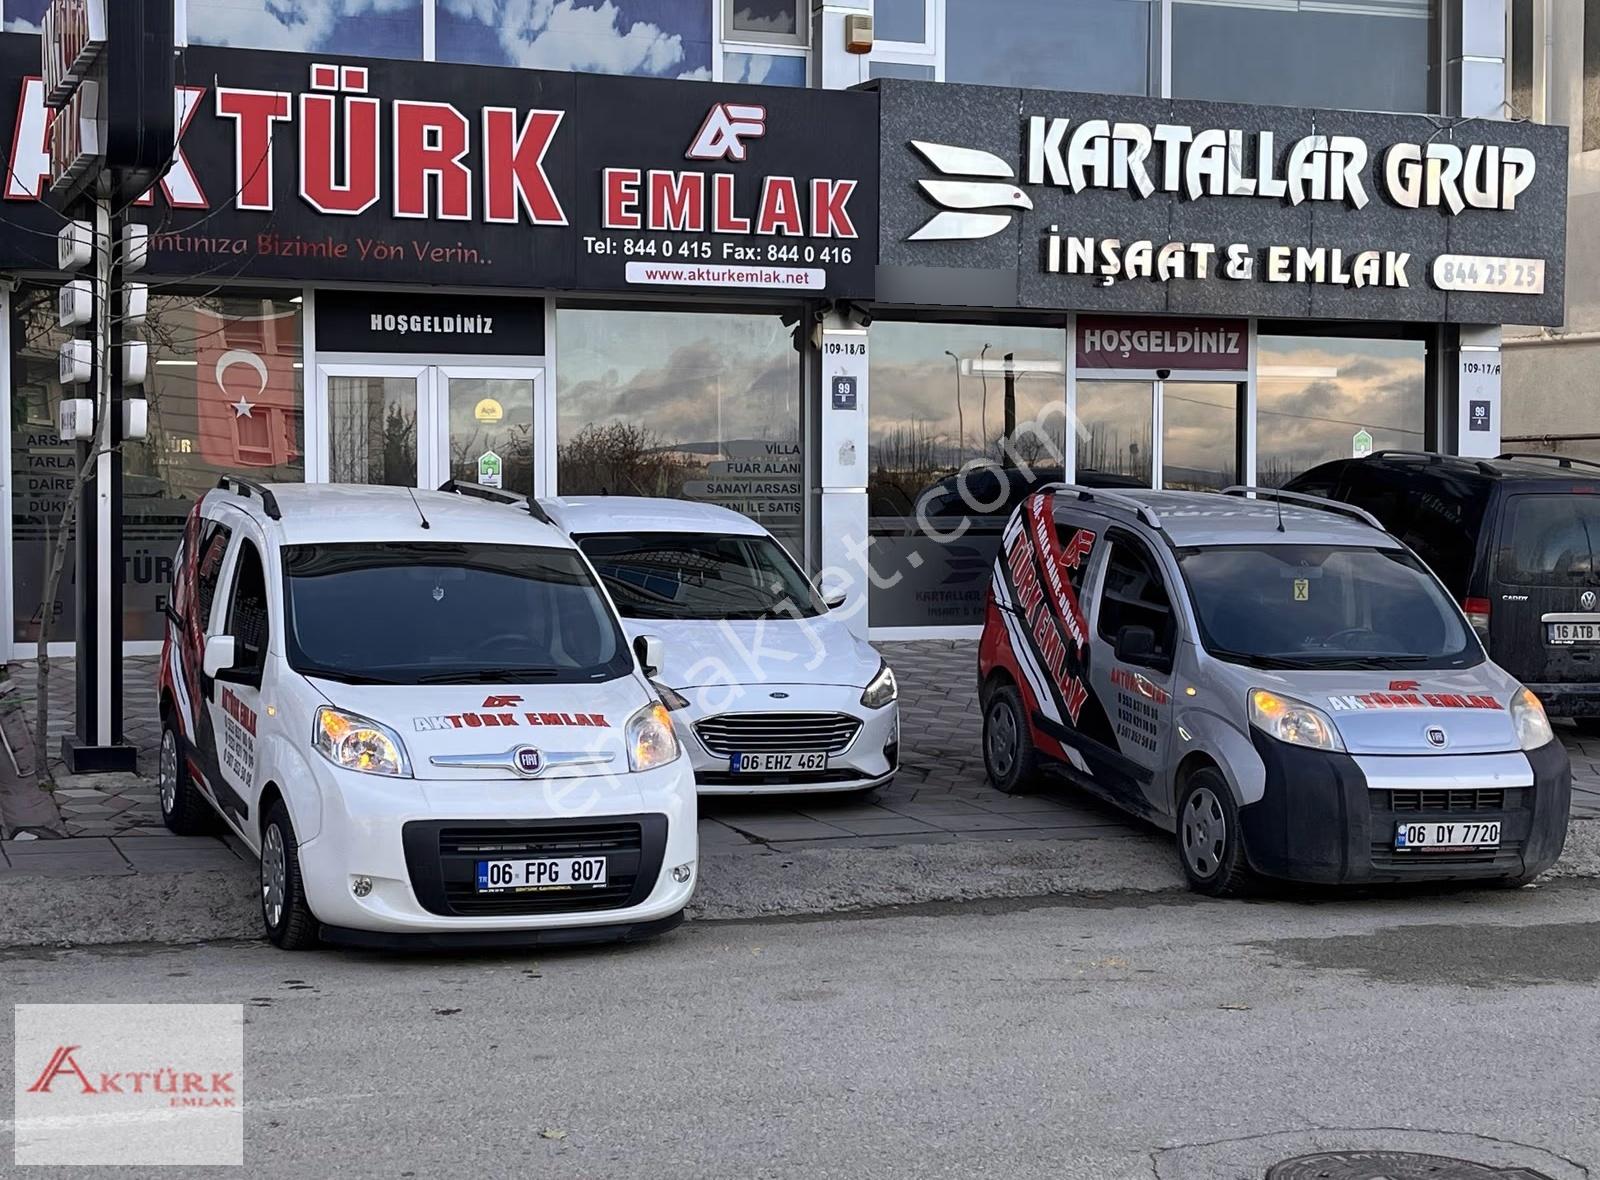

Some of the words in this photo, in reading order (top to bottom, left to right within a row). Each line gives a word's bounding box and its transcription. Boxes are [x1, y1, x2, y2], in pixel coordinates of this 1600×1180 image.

[1028, 115, 1369, 210] KARTALLAR
[1384, 142, 1537, 216] GRUP
[602, 167, 858, 239] EMLAK
[256, 234, 348, 259] Bizimle
[356, 238, 404, 261] Yön
[583, 236, 618, 255] Tel:
[623, 239, 657, 257] 844
[662, 241, 673, 257] 0
[678, 241, 712, 259] 415
[722, 242, 761, 260] Fax:
[767, 245, 800, 262] 844
[804, 246, 815, 263] 0
[820, 247, 852, 264] 416
[1047, 223, 1214, 287] İNŞAAT
[1224, 243, 1254, 280] &
[1267, 246, 1410, 288] EMLAK
[645, 267, 810, 285] www.akturkemlak.net
[1443, 262, 1479, 284] 844
[1485, 264, 1507, 285] 25
[1514, 265, 1536, 287] 25
[370, 313, 493, 334] HOŞGELDİNİZ
[825, 342, 866, 355] 109-18/B
[1084, 327, 1240, 358] HOŞGELDİNİZ
[838, 383, 850, 394] 99
[1475, 406, 1485, 417] 99
[765, 443, 801, 455] VİLLA
[27, 456, 76, 468] TARLA
[727, 463, 761, 473] FUAR
[764, 464, 801, 474] ALANI
[28, 477, 76, 490] DAİRE
[706, 482, 752, 494] SANAYİ
[755, 483, 801, 494] ARSASI
[768, 502, 801, 515] SATIŞ
[1556, 625, 1569, 639] 16
[1572, 625, 1594, 639] ATB
[1327, 692, 1425, 711] AKTÜRK
[1421, 693, 1505, 710] EMLAK
[413, 712, 520, 732] AKTÜRK
[525, 712, 612, 728] EMLAK
[521, 754, 538, 768] FIAT
[741, 755, 760, 770] 06
[765, 755, 792, 770] EHZ
[798, 754, 824, 769] 462
[1408, 825, 1426, 843] 06
[1437, 825, 1455, 843] DY
[1462, 824, 1498, 843] 7720
[490, 863, 513, 885] 06
[525, 862, 559, 883] FPG
[571, 859, 604, 882] 807
